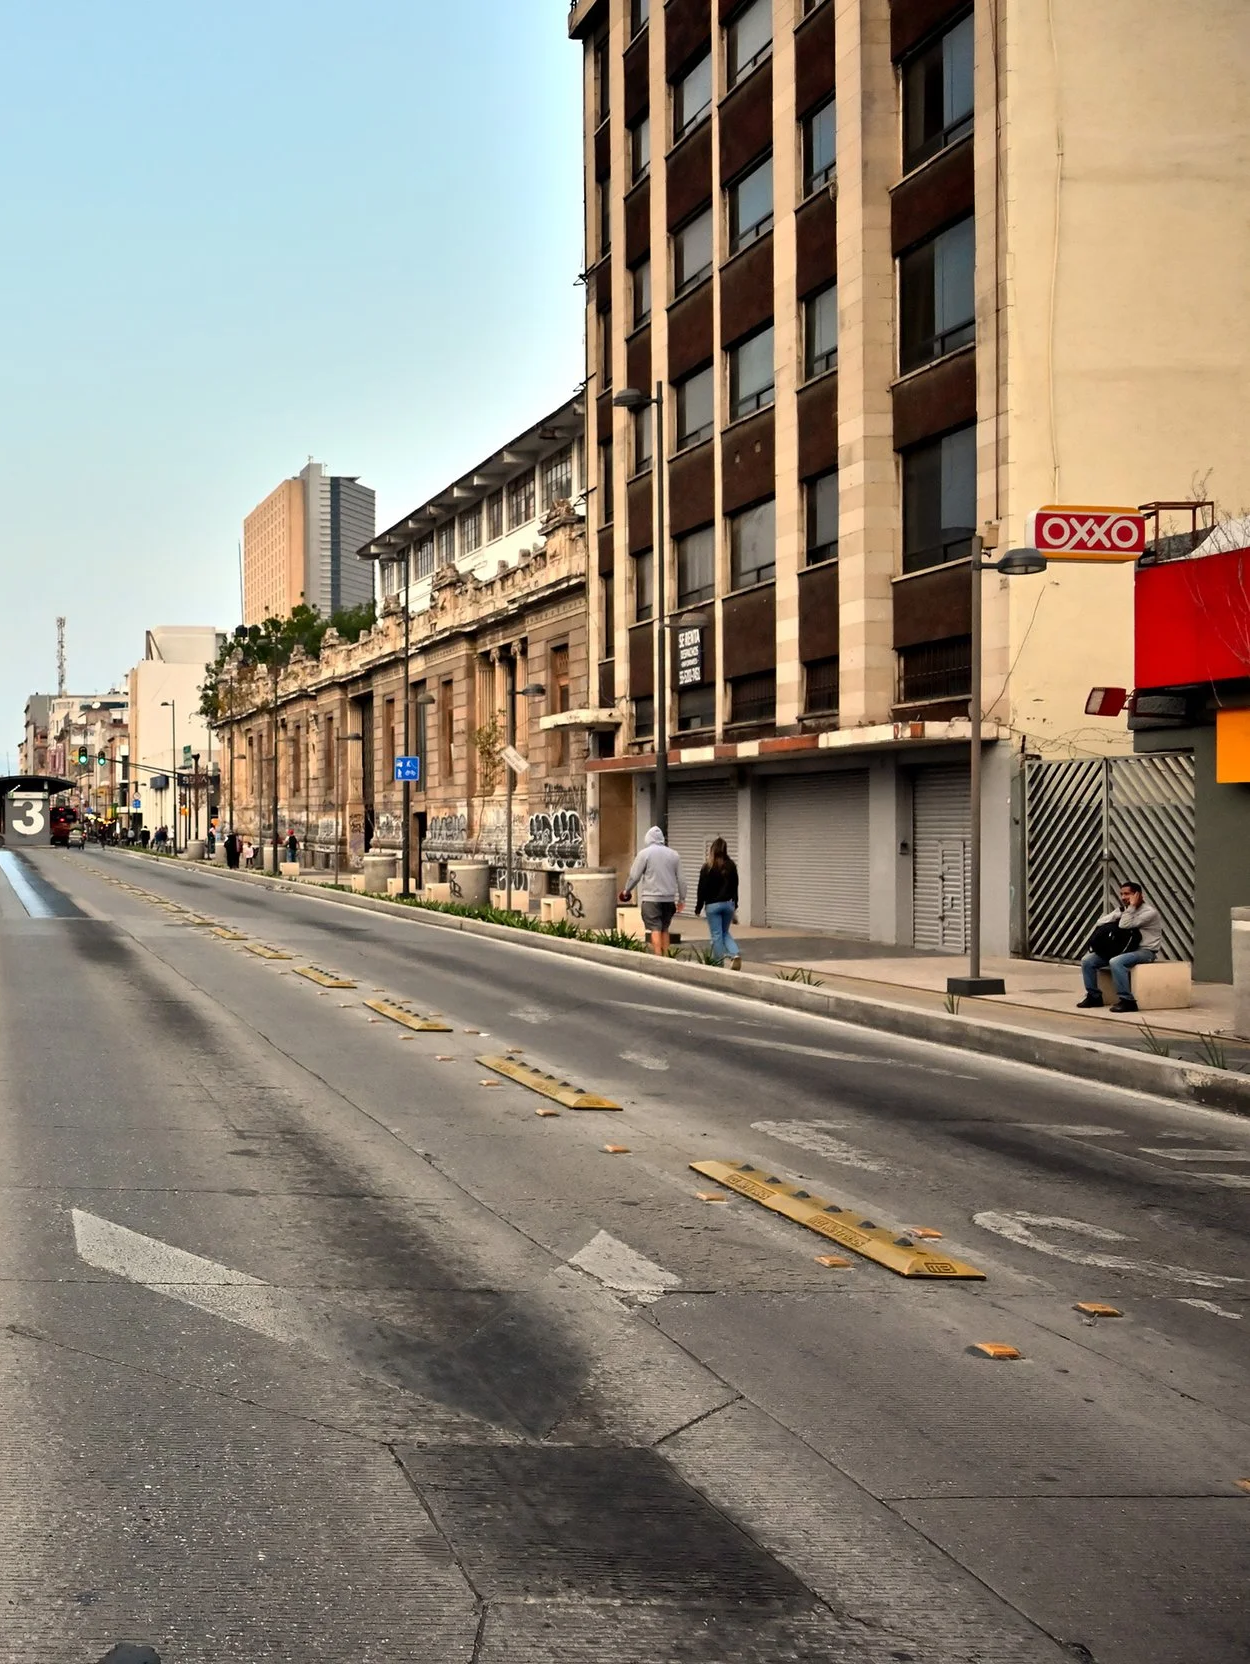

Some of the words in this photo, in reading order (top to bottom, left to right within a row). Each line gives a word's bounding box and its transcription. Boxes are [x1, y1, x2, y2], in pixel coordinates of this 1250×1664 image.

[1042, 514, 1139, 551] OXXO
[685, 629, 701, 646] RENTA
[12, 799, 45, 835] 3
